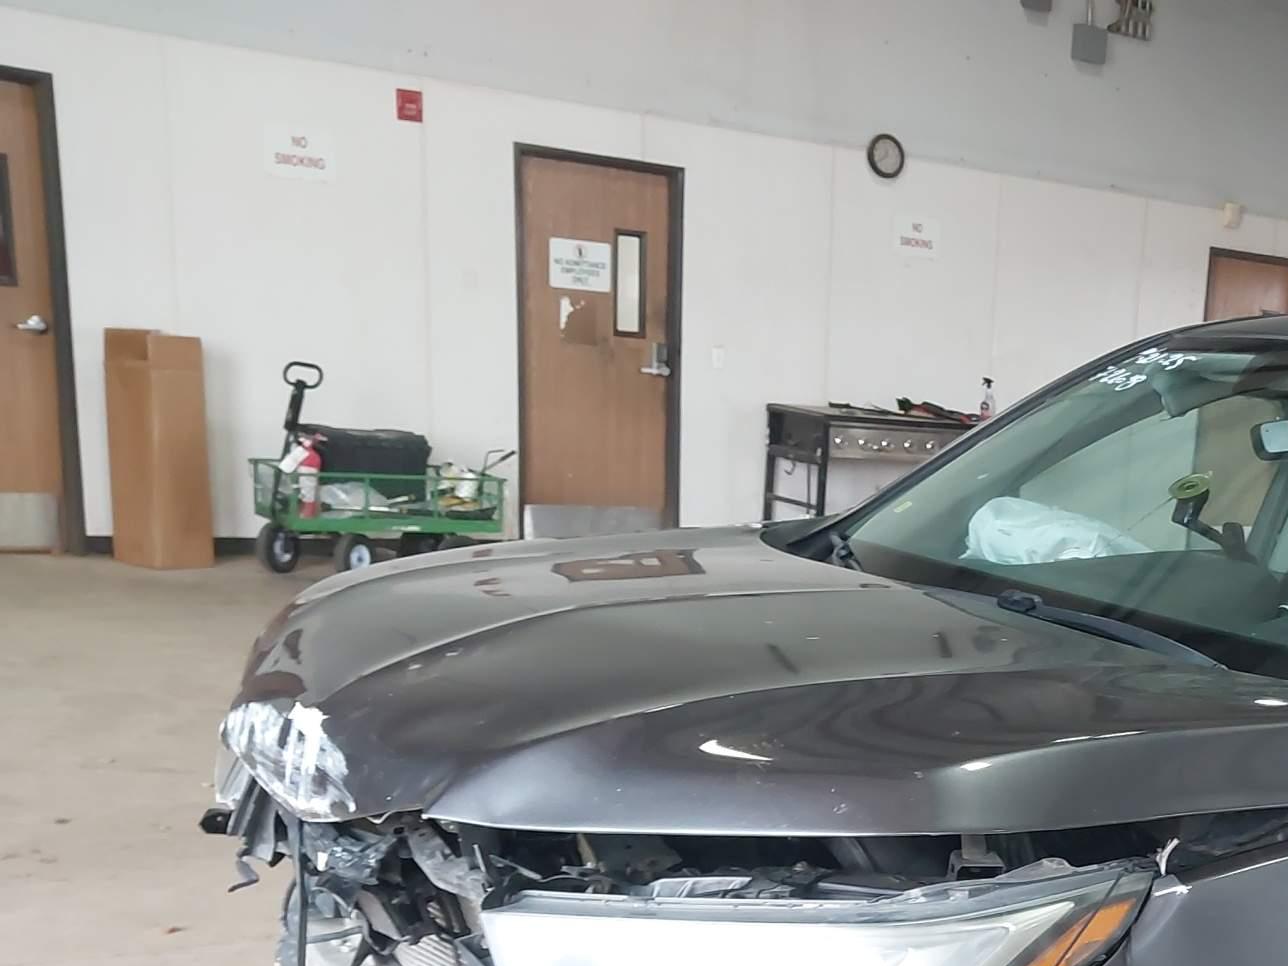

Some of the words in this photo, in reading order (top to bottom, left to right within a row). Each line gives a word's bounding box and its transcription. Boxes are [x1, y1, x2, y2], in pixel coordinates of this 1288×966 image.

[291, 136, 308, 149] NO
[274, 152, 326, 170] SMOKING
[912, 222, 923, 233] NO
[900, 236, 933, 250] SMOKING
